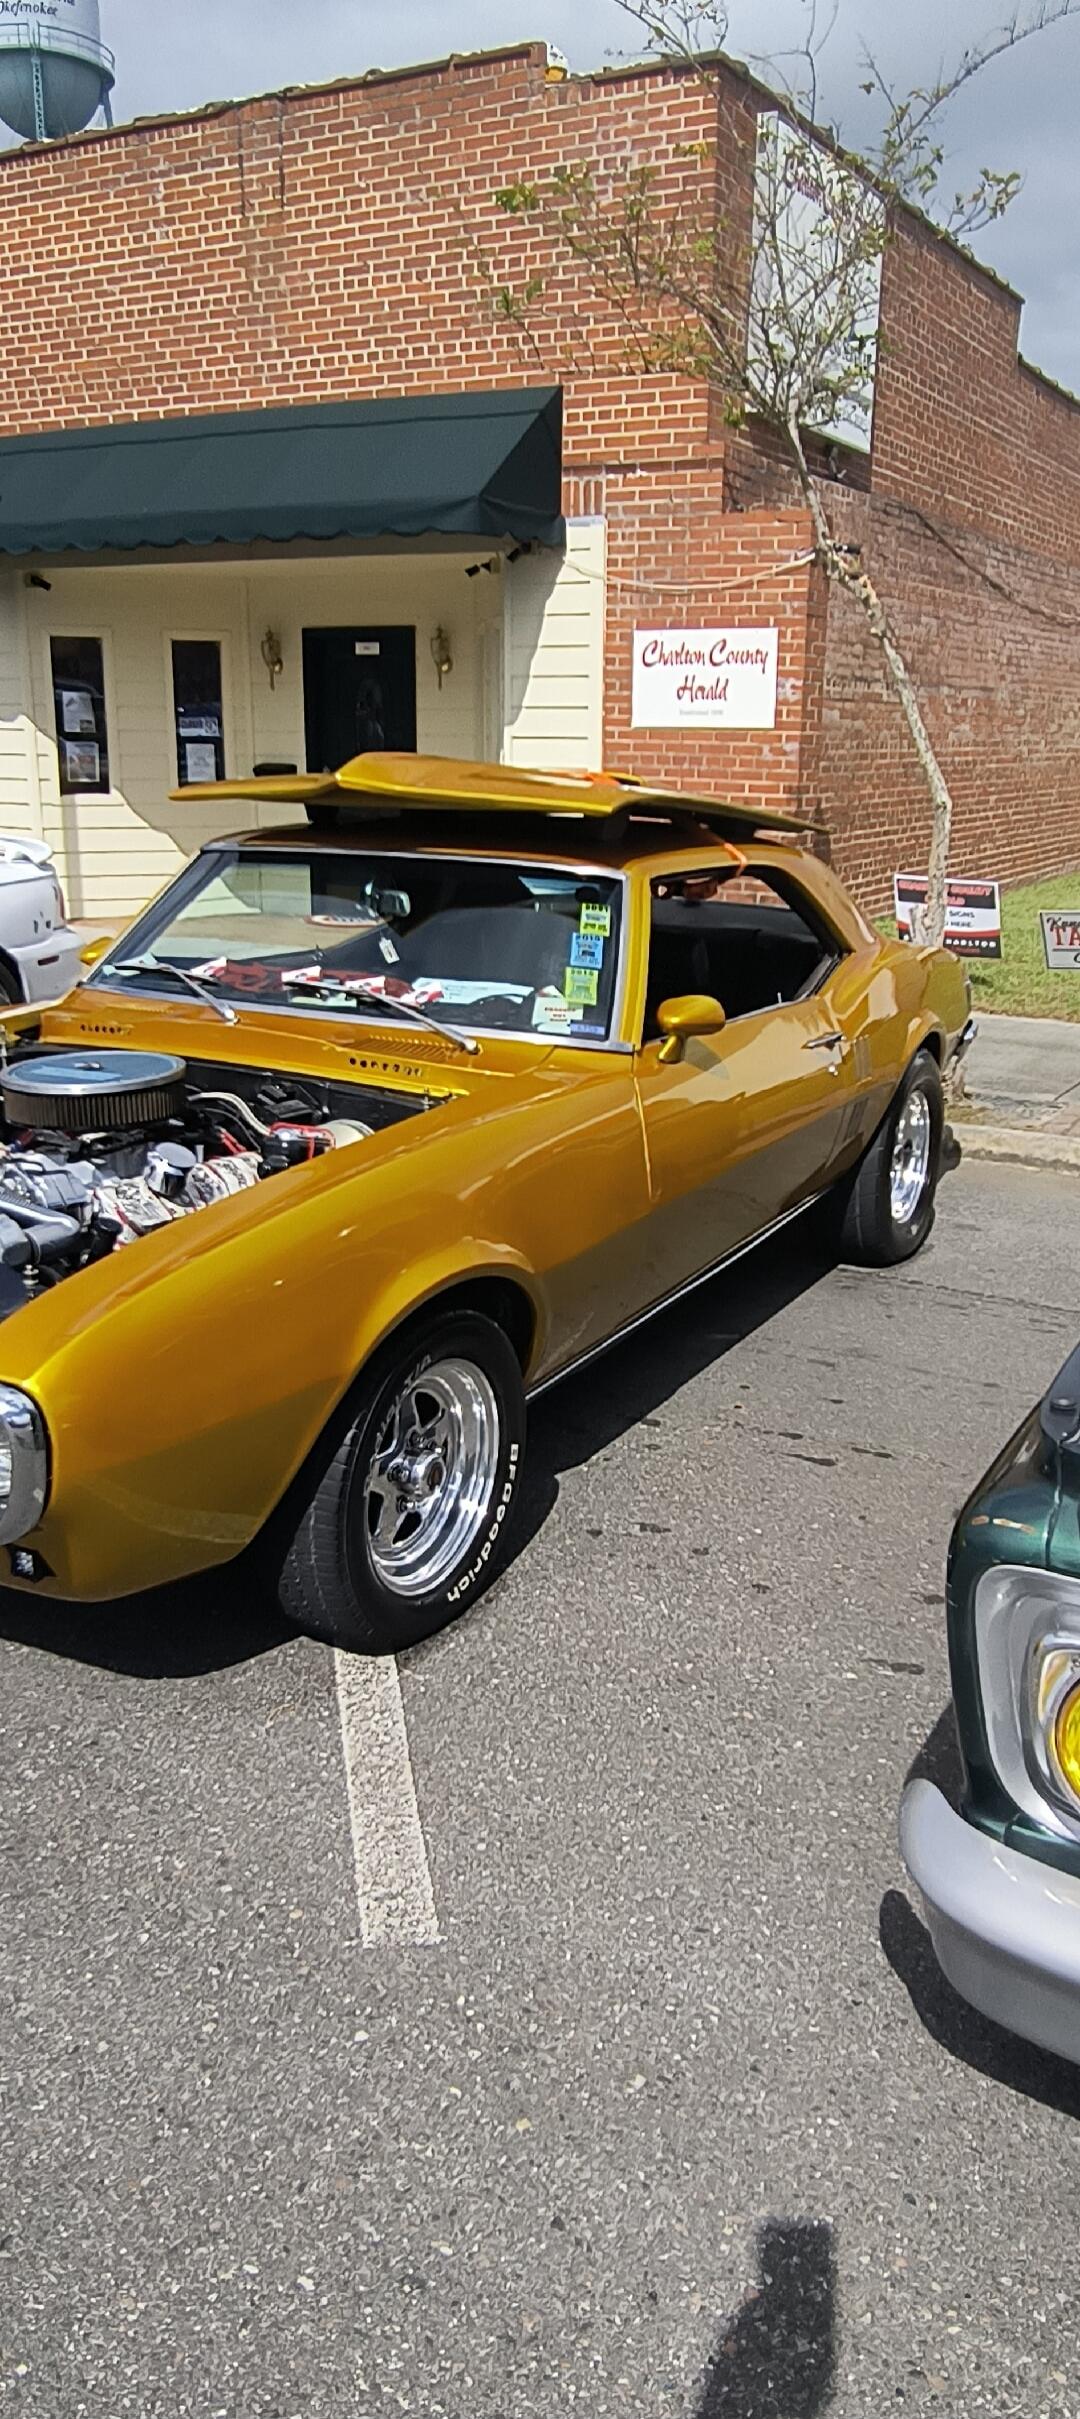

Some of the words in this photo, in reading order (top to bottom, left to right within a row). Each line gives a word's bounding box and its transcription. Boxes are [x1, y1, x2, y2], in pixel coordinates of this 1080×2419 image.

[642, 639, 705, 667] Charlton
[709, 638, 769, 675] County
[676, 674, 729, 703] Herald
[447, 1443, 519, 1602] BFGoodrich
